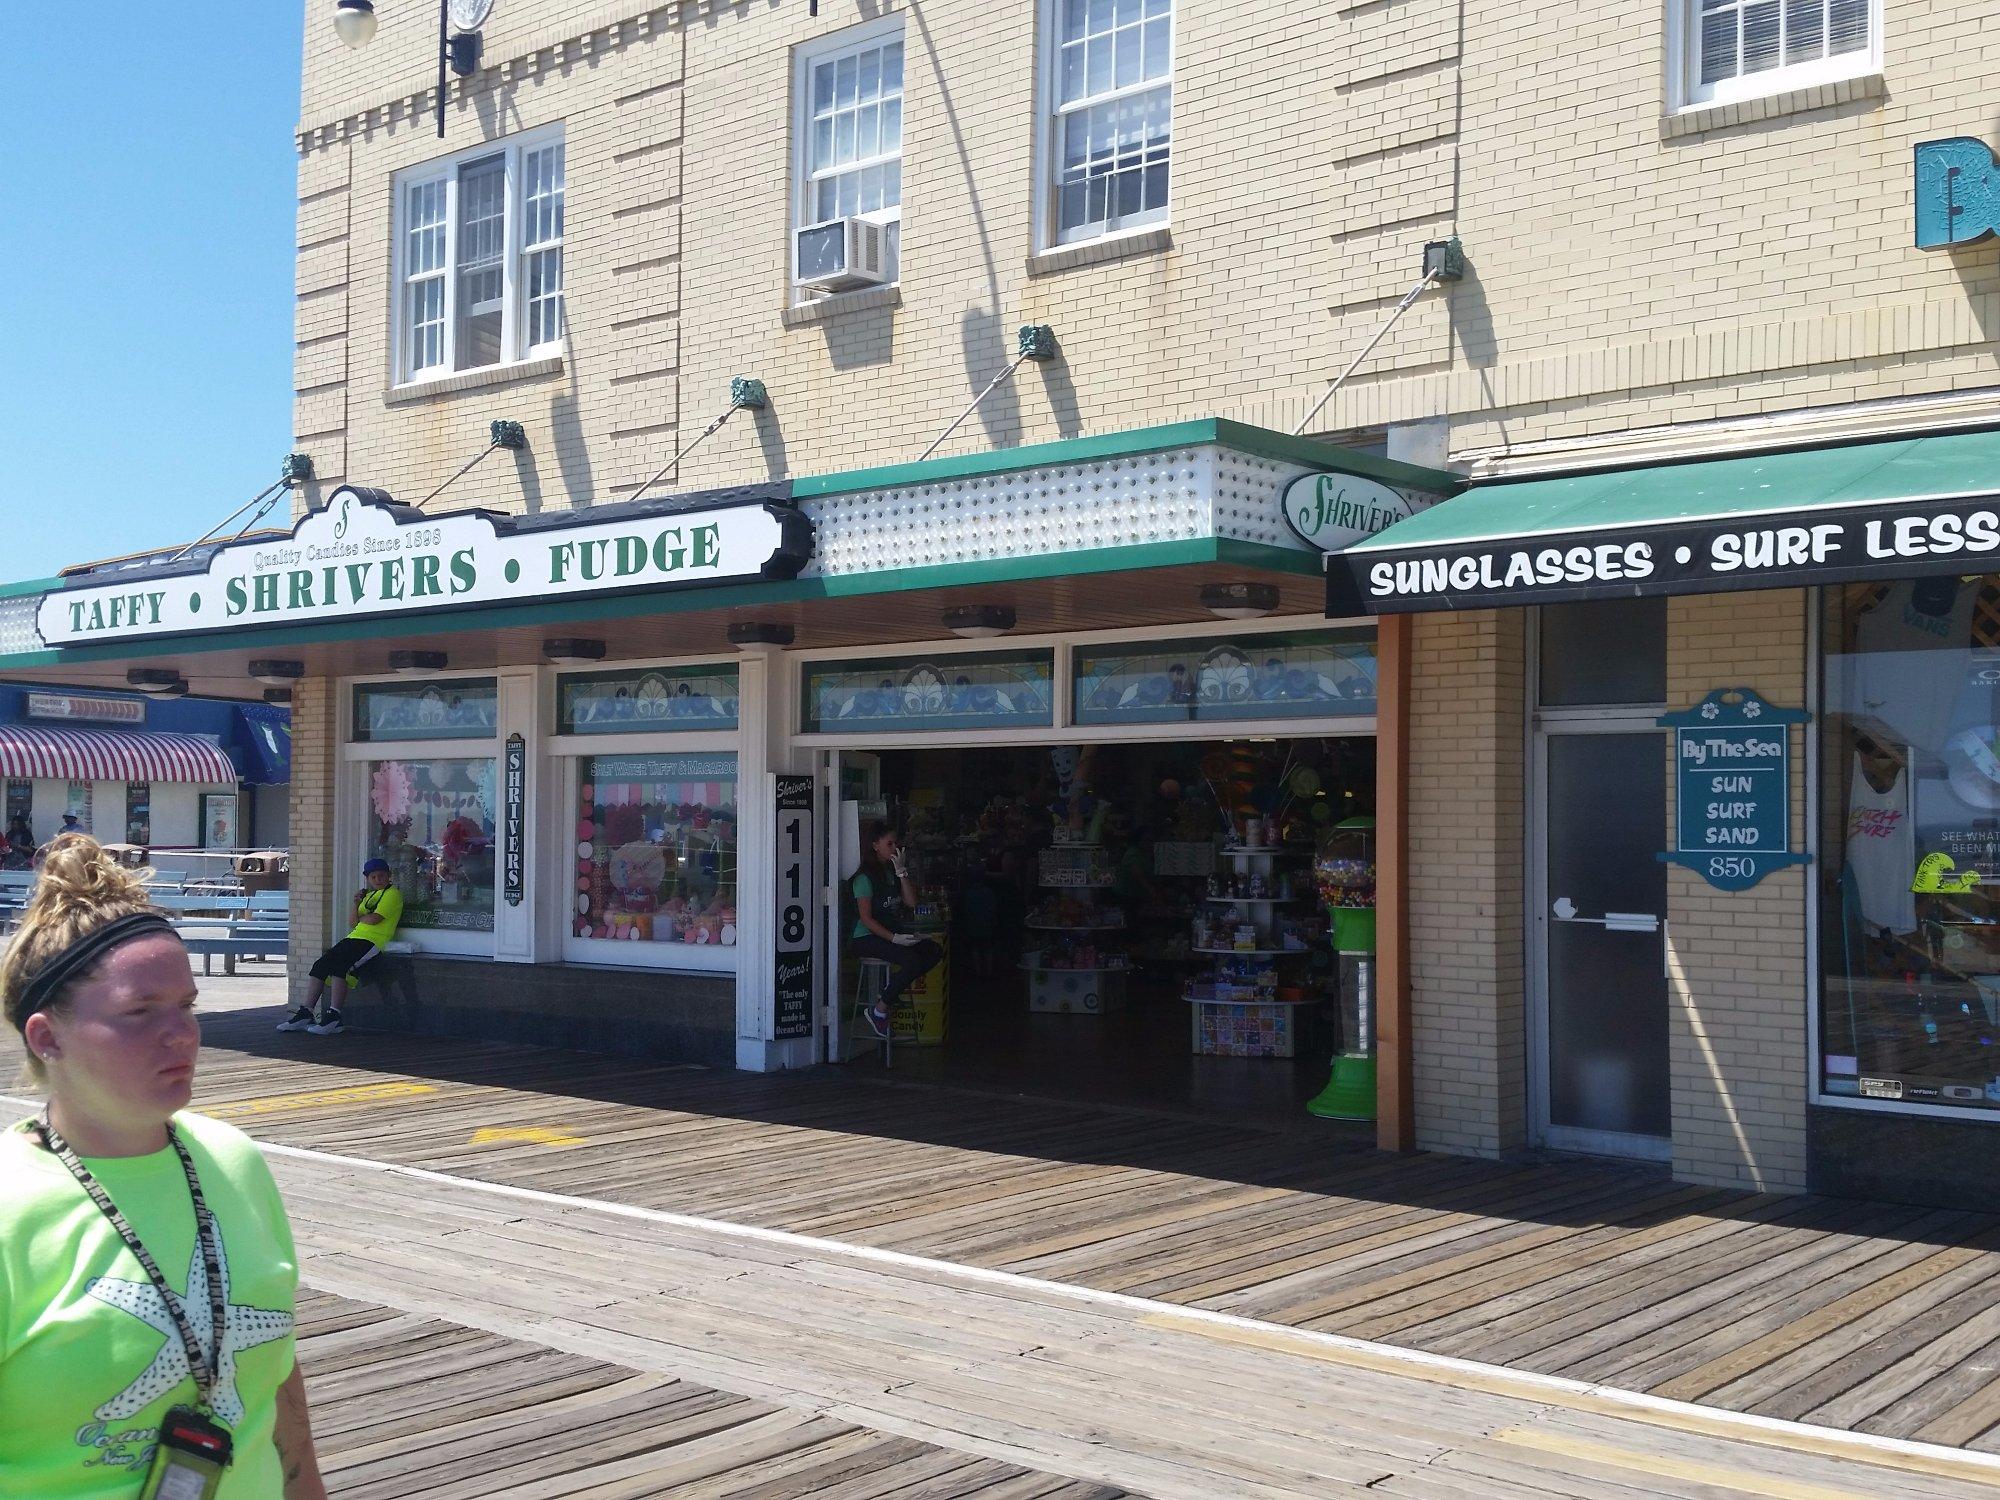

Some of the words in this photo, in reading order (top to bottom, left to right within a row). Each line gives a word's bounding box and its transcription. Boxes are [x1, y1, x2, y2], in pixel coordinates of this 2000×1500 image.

[253, 547, 302, 571] Quality
[306, 541, 359, 562] Candies
[363, 536, 401, 555] Since
[405, 528, 442, 549] 1898
[1370, 542, 1654, 596] SUNGLASSES
[1710, 524, 1844, 571] SURF
[68, 591, 166, 632] TAFFY
[226, 546, 477, 618] SHRIVERS
[548, 522, 720, 584] FUDGE
[1682, 739, 1706, 764] By
[1705, 739, 1745, 757] The
[1744, 738, 1782, 757] Sea
[647, 760, 678, 776] TAFFY
[1711, 776, 1753, 793] SUN
[507, 752, 521, 887] SHRIVERS
[1706, 803, 1758, 819] SURF
[1705, 827, 1759, 845] SAND
[1941, 831, 1963, 841] SEE
[1952, 844, 1982, 853] BEEN
[1709, 857, 1756, 878] 850
[784, 1001, 803, 1011] TAFFY
[781, 1013, 799, 1022] made
[799, 1012, 806, 1021] in
[57, 1147, 88, 1178] PINK
[83, 1178, 112, 1210] PINK
[110, 1212, 139, 1244] PINK
